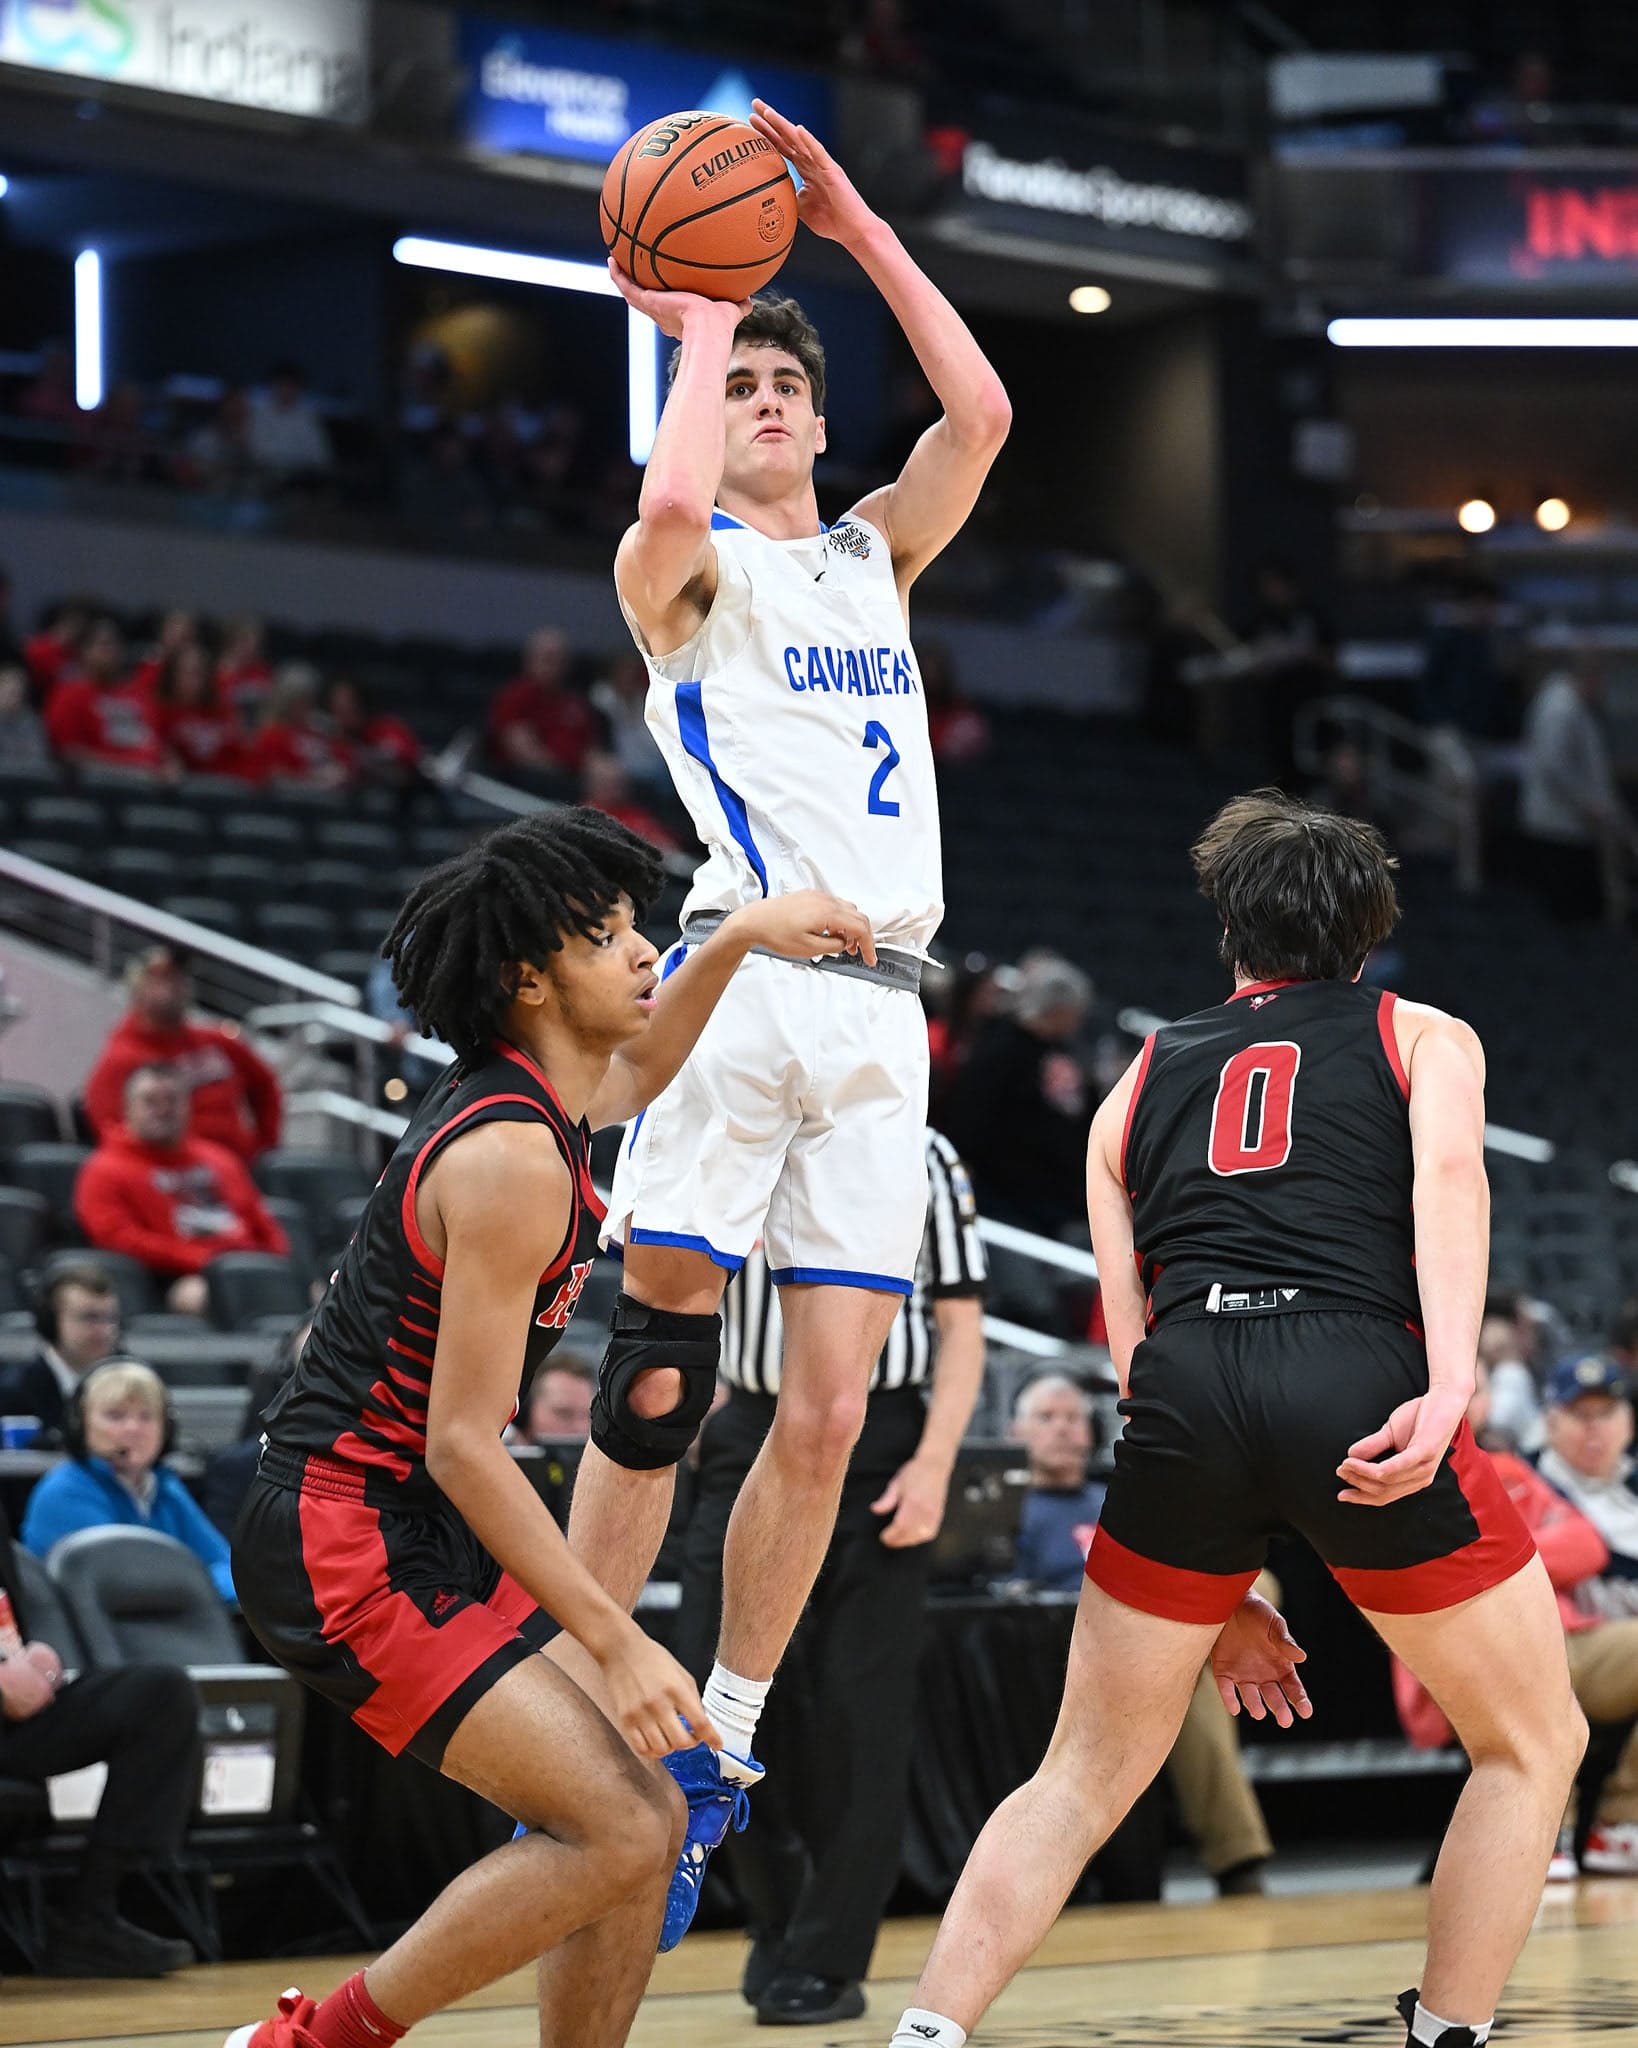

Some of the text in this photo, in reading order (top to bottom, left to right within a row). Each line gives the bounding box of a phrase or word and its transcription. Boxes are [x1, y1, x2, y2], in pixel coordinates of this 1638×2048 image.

[783, 646, 918, 697] CAVALIER
[862, 720, 900, 818] 2
[1208, 1041, 1301, 1177] 0
